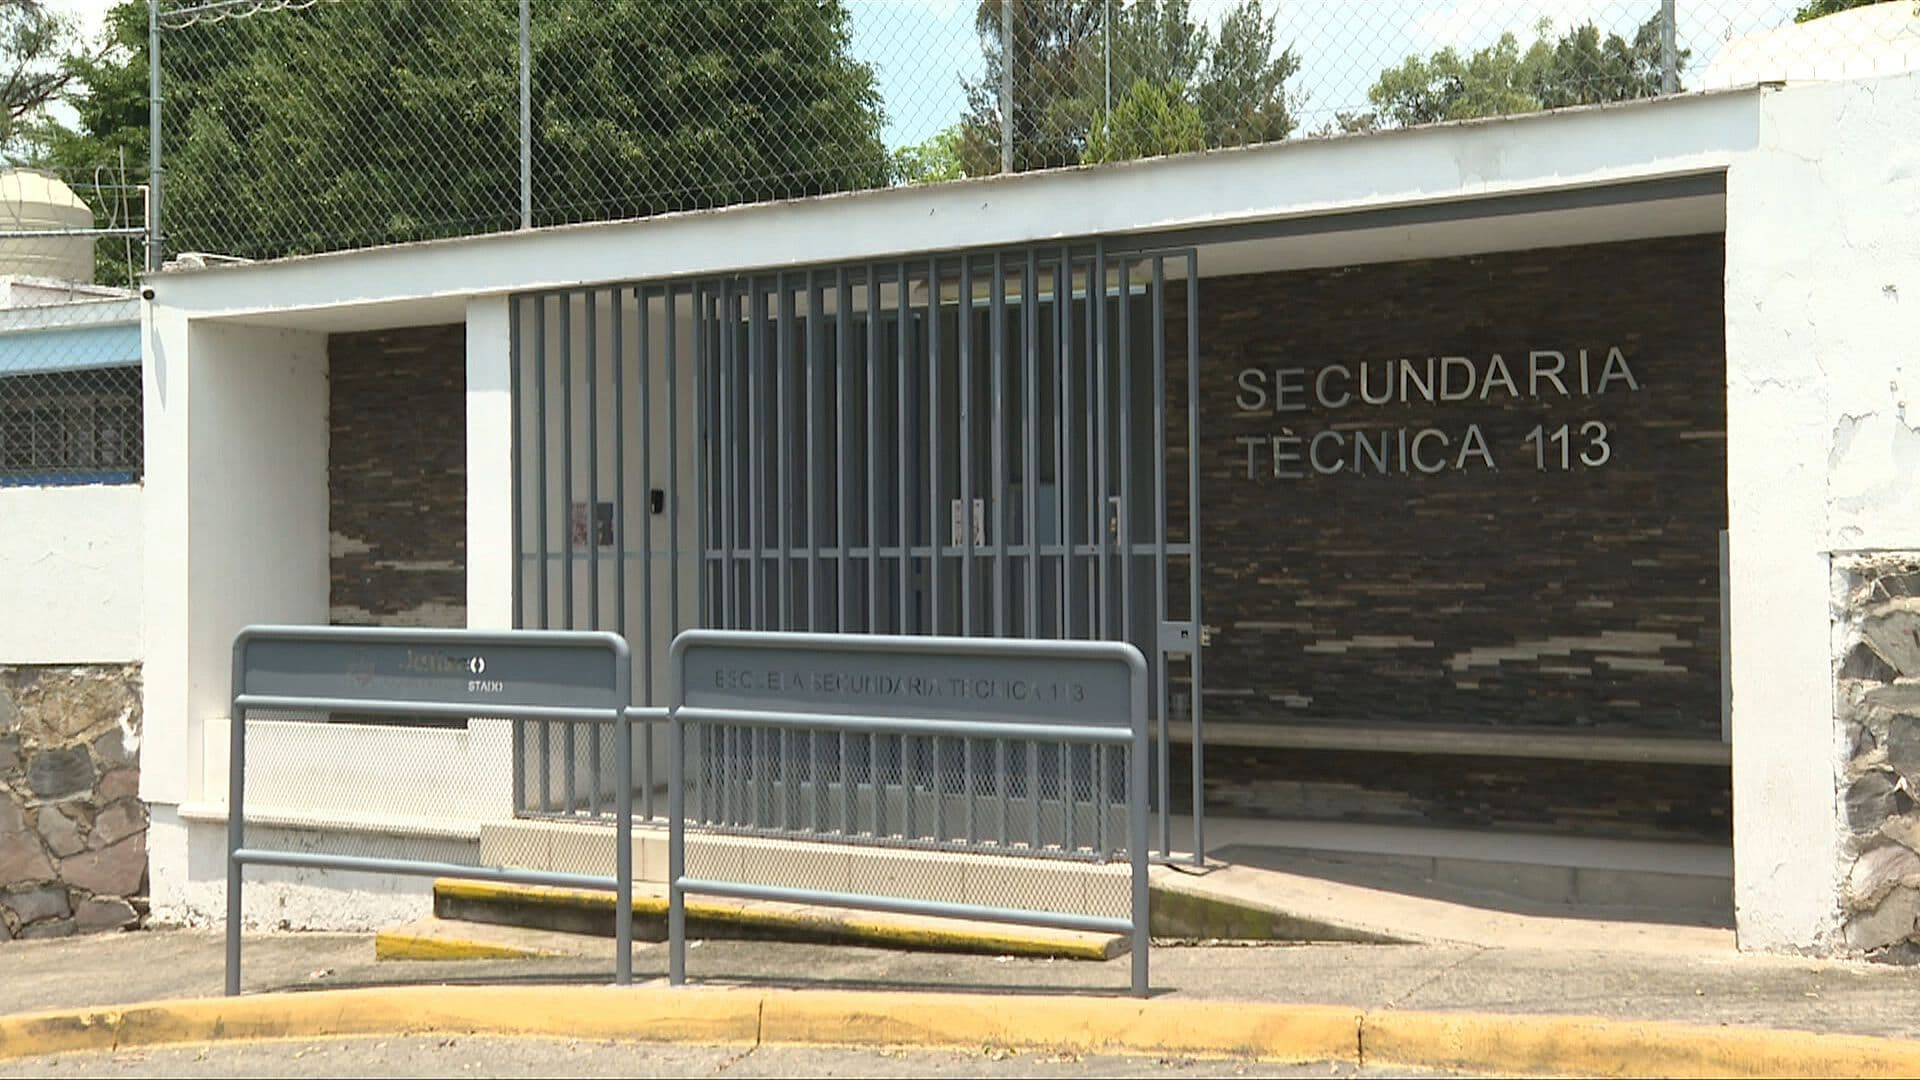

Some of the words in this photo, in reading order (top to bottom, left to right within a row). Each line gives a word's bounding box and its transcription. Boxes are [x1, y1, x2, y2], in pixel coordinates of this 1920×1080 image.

[1235, 346, 1640, 412] SECUNDARIA
[1525, 421, 1612, 470] 113
[714, 670, 804, 691] ESCELA
[809, 672, 942, 697] SECUNDARIA
